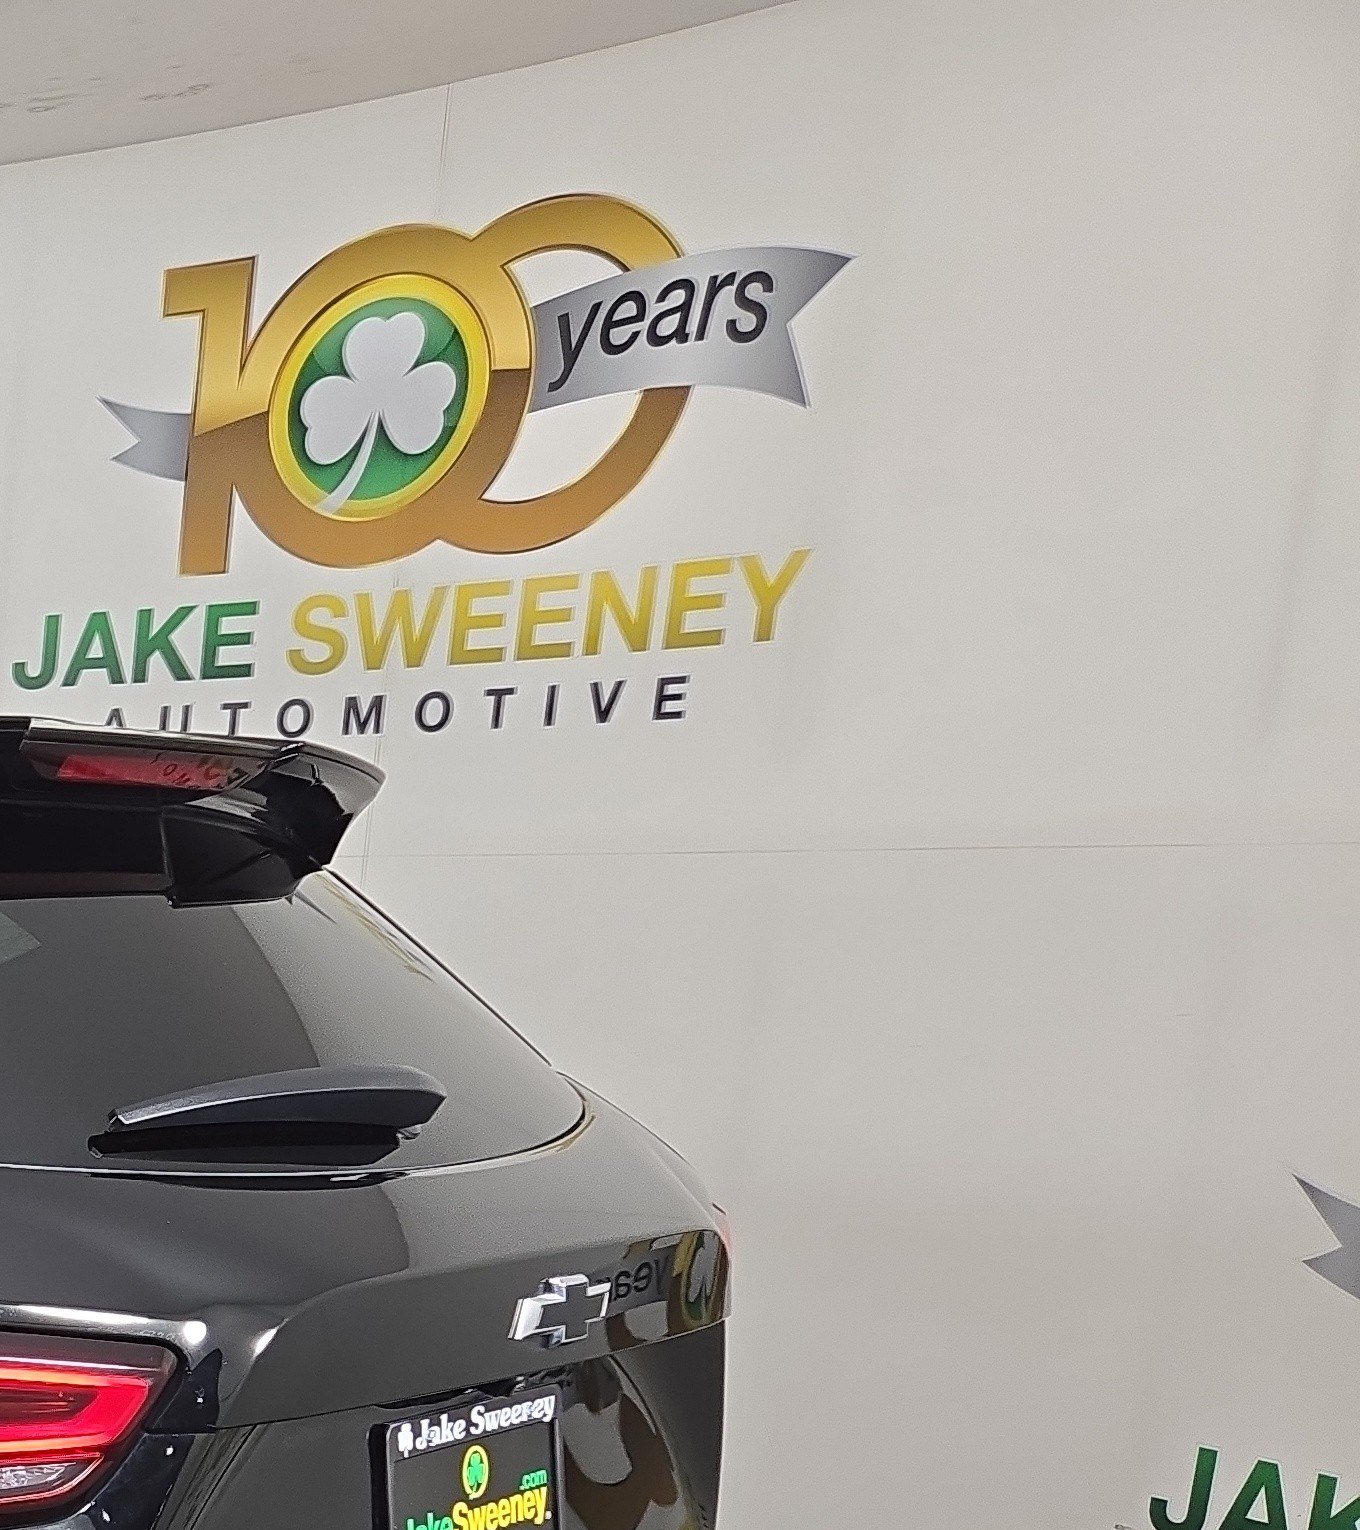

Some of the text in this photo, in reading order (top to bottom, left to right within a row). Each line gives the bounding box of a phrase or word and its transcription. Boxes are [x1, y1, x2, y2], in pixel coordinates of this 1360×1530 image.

[549, 266, 774, 393] years
[12, 549, 813, 690] JAKE SWEENEY
[415, 1413, 467, 1450] Jake
[519, 1470, 547, 1490] .com
